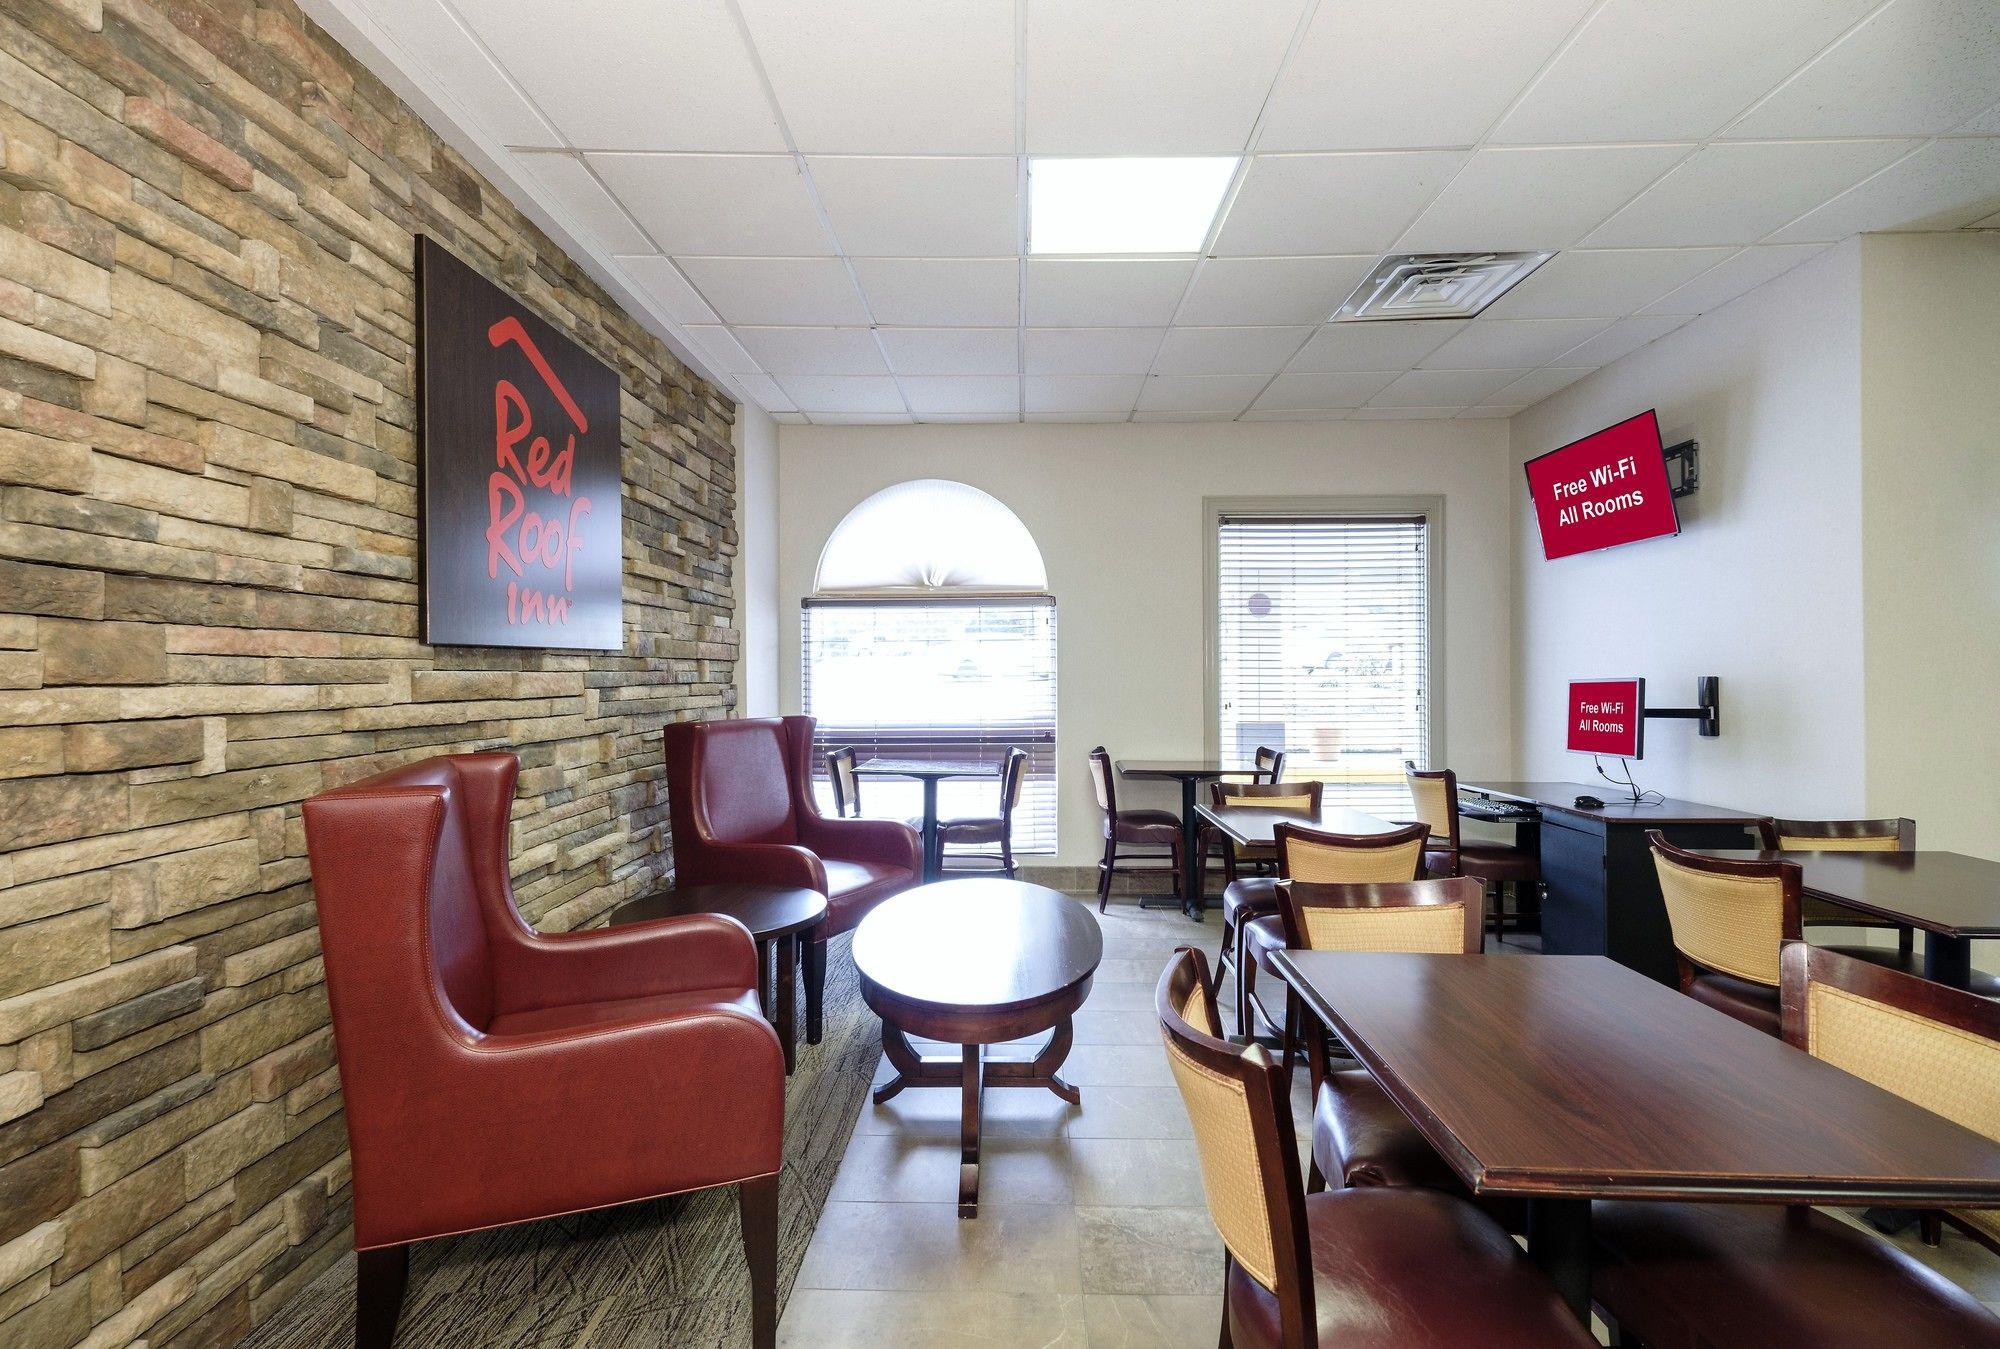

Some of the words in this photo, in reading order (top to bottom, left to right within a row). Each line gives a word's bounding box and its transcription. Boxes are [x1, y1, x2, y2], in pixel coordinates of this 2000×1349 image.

[495, 379, 576, 496] Red
[1552, 478, 1587, 500] Free
[1589, 456, 1637, 488] Wi-Fi
[1559, 505, 1579, 527] All
[1581, 490, 1644, 520] Rooms
[486, 471, 592, 591] Roof
[1579, 719, 1590, 731] All
[1592, 719, 1624, 733] Rooms
[1580, 702, 1599, 714] Free
[1601, 702, 1624, 715] Wi-Fi
